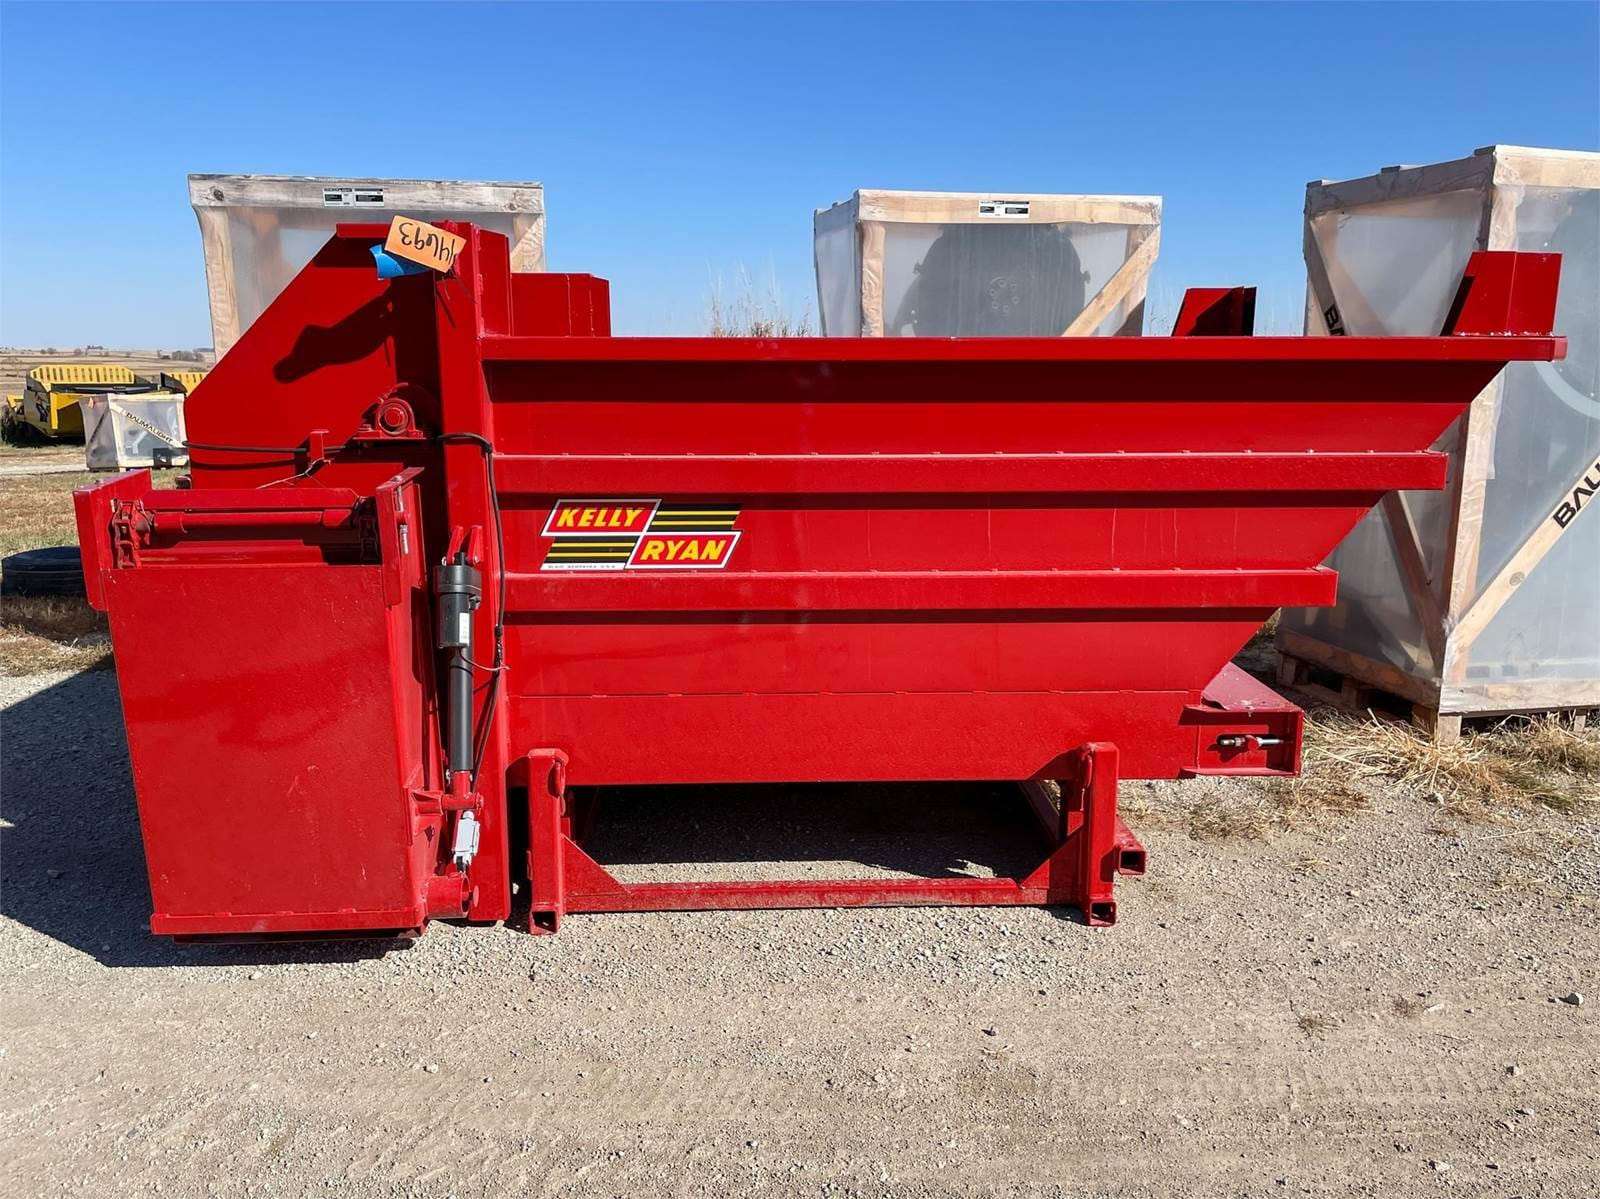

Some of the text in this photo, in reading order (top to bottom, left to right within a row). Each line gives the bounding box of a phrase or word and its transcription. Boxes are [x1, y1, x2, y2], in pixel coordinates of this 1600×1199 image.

[399, 222, 456, 265] 14693
[556, 507, 643, 527] KELLY
[640, 540, 726, 560] RYAN
